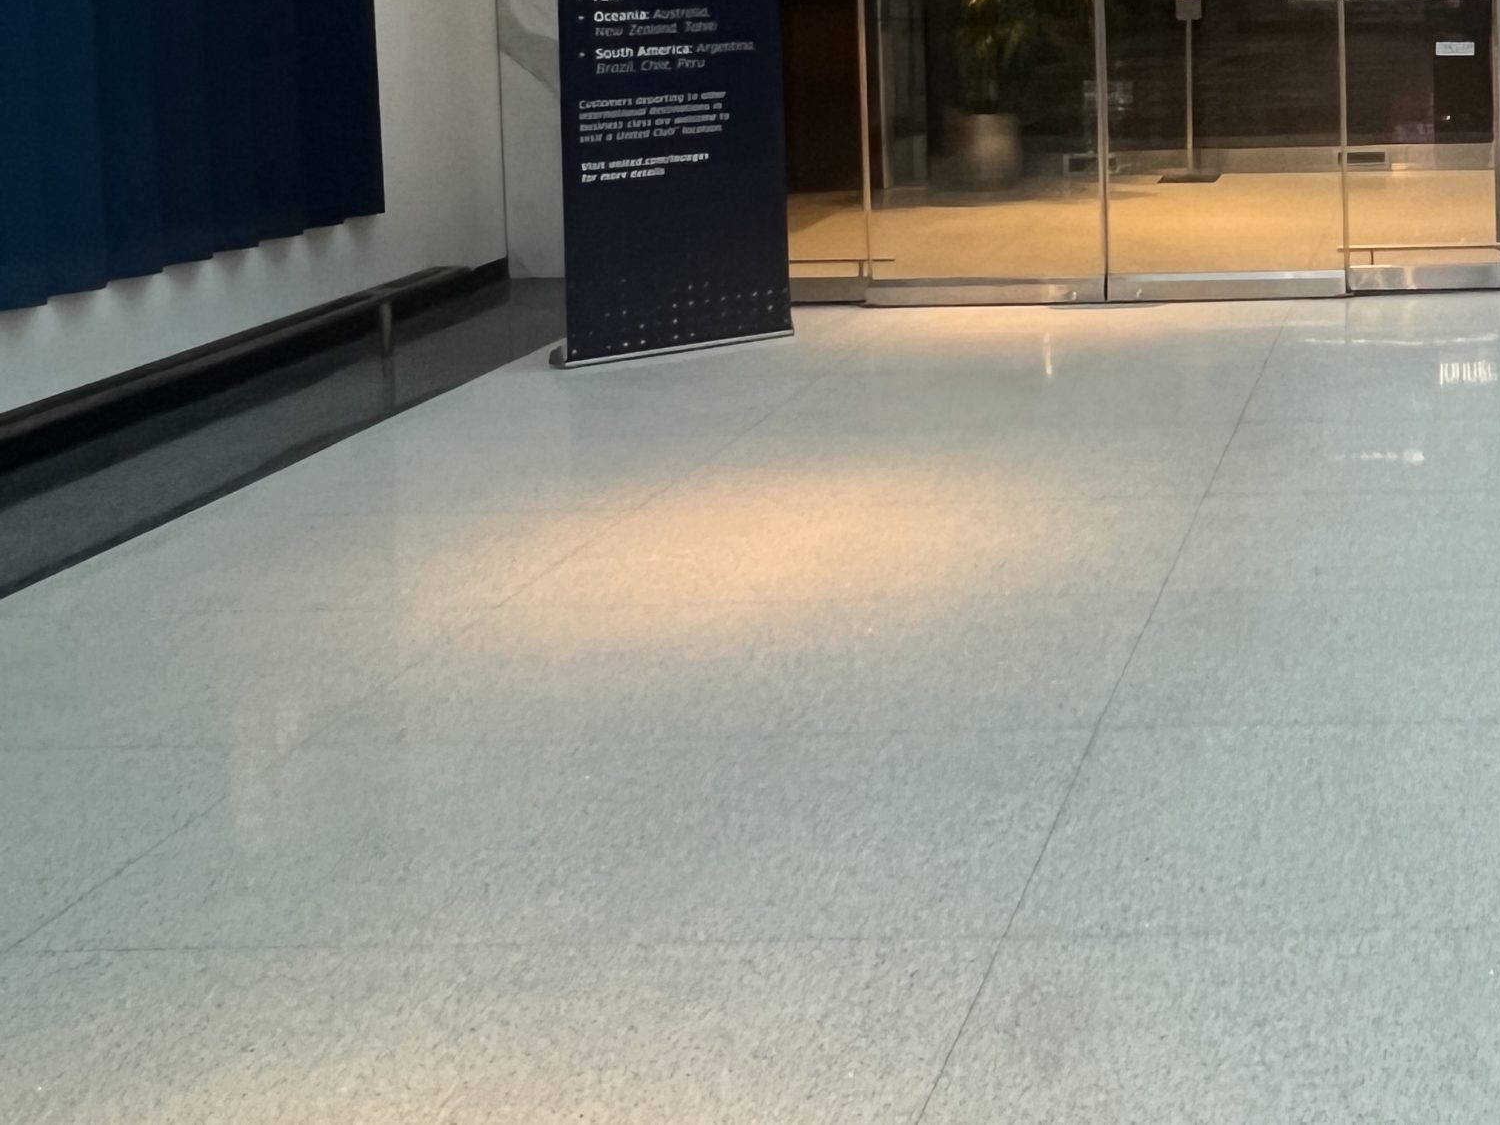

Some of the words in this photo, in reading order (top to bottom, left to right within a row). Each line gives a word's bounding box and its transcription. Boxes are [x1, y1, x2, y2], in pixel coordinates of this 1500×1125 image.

[593, 10, 650, 22] Oceania:
[595, 25, 623, 37] New
[595, 47, 633, 59] South
[637, 45, 693, 57] America:
